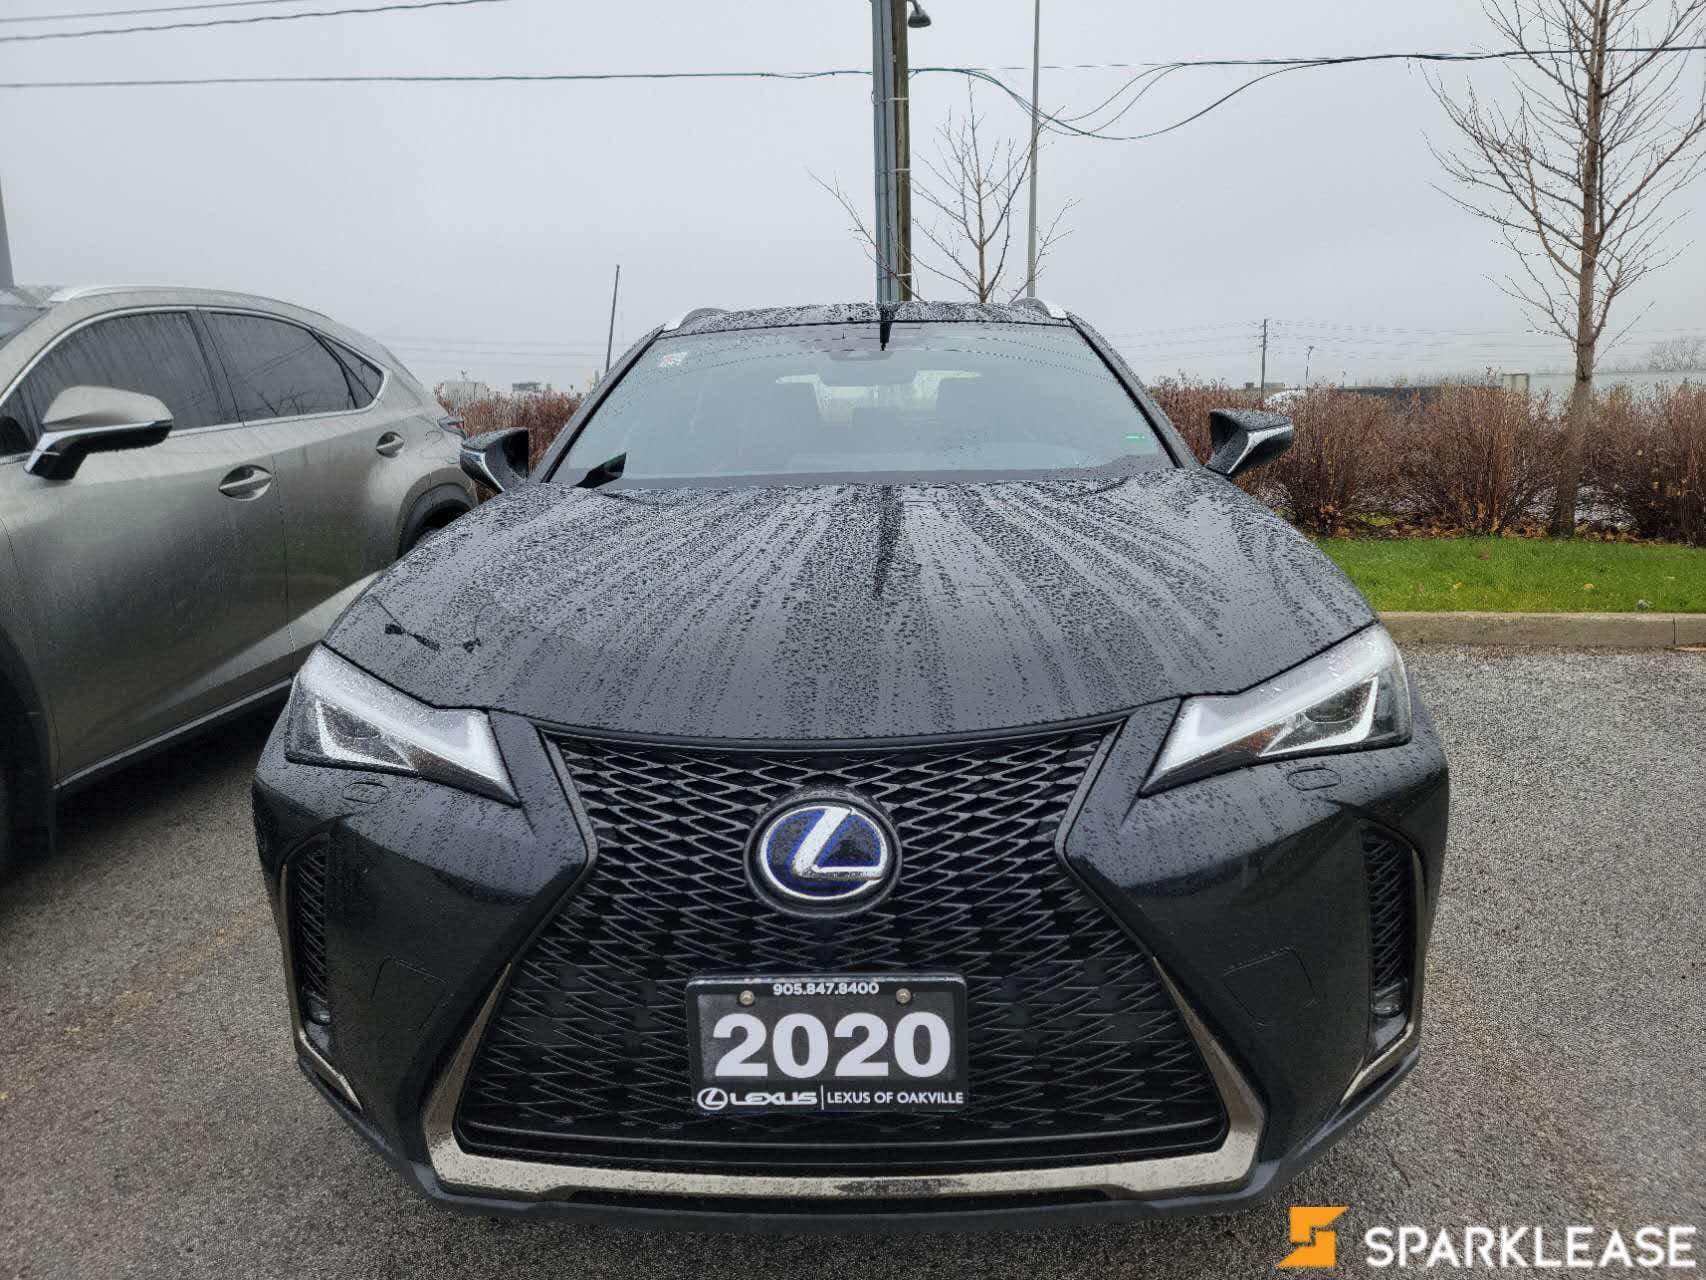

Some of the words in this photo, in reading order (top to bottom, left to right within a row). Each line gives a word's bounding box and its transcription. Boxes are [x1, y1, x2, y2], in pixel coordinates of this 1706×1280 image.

[773, 982, 879, 996] 905.847.8400
[713, 1011, 950, 1078] 2020
[730, 1092, 818, 1106] LEXUS
[827, 1092, 871, 1104] LEXUS
[876, 1092, 893, 1104] OF
[898, 1091, 963, 1104] OAKVILLE
